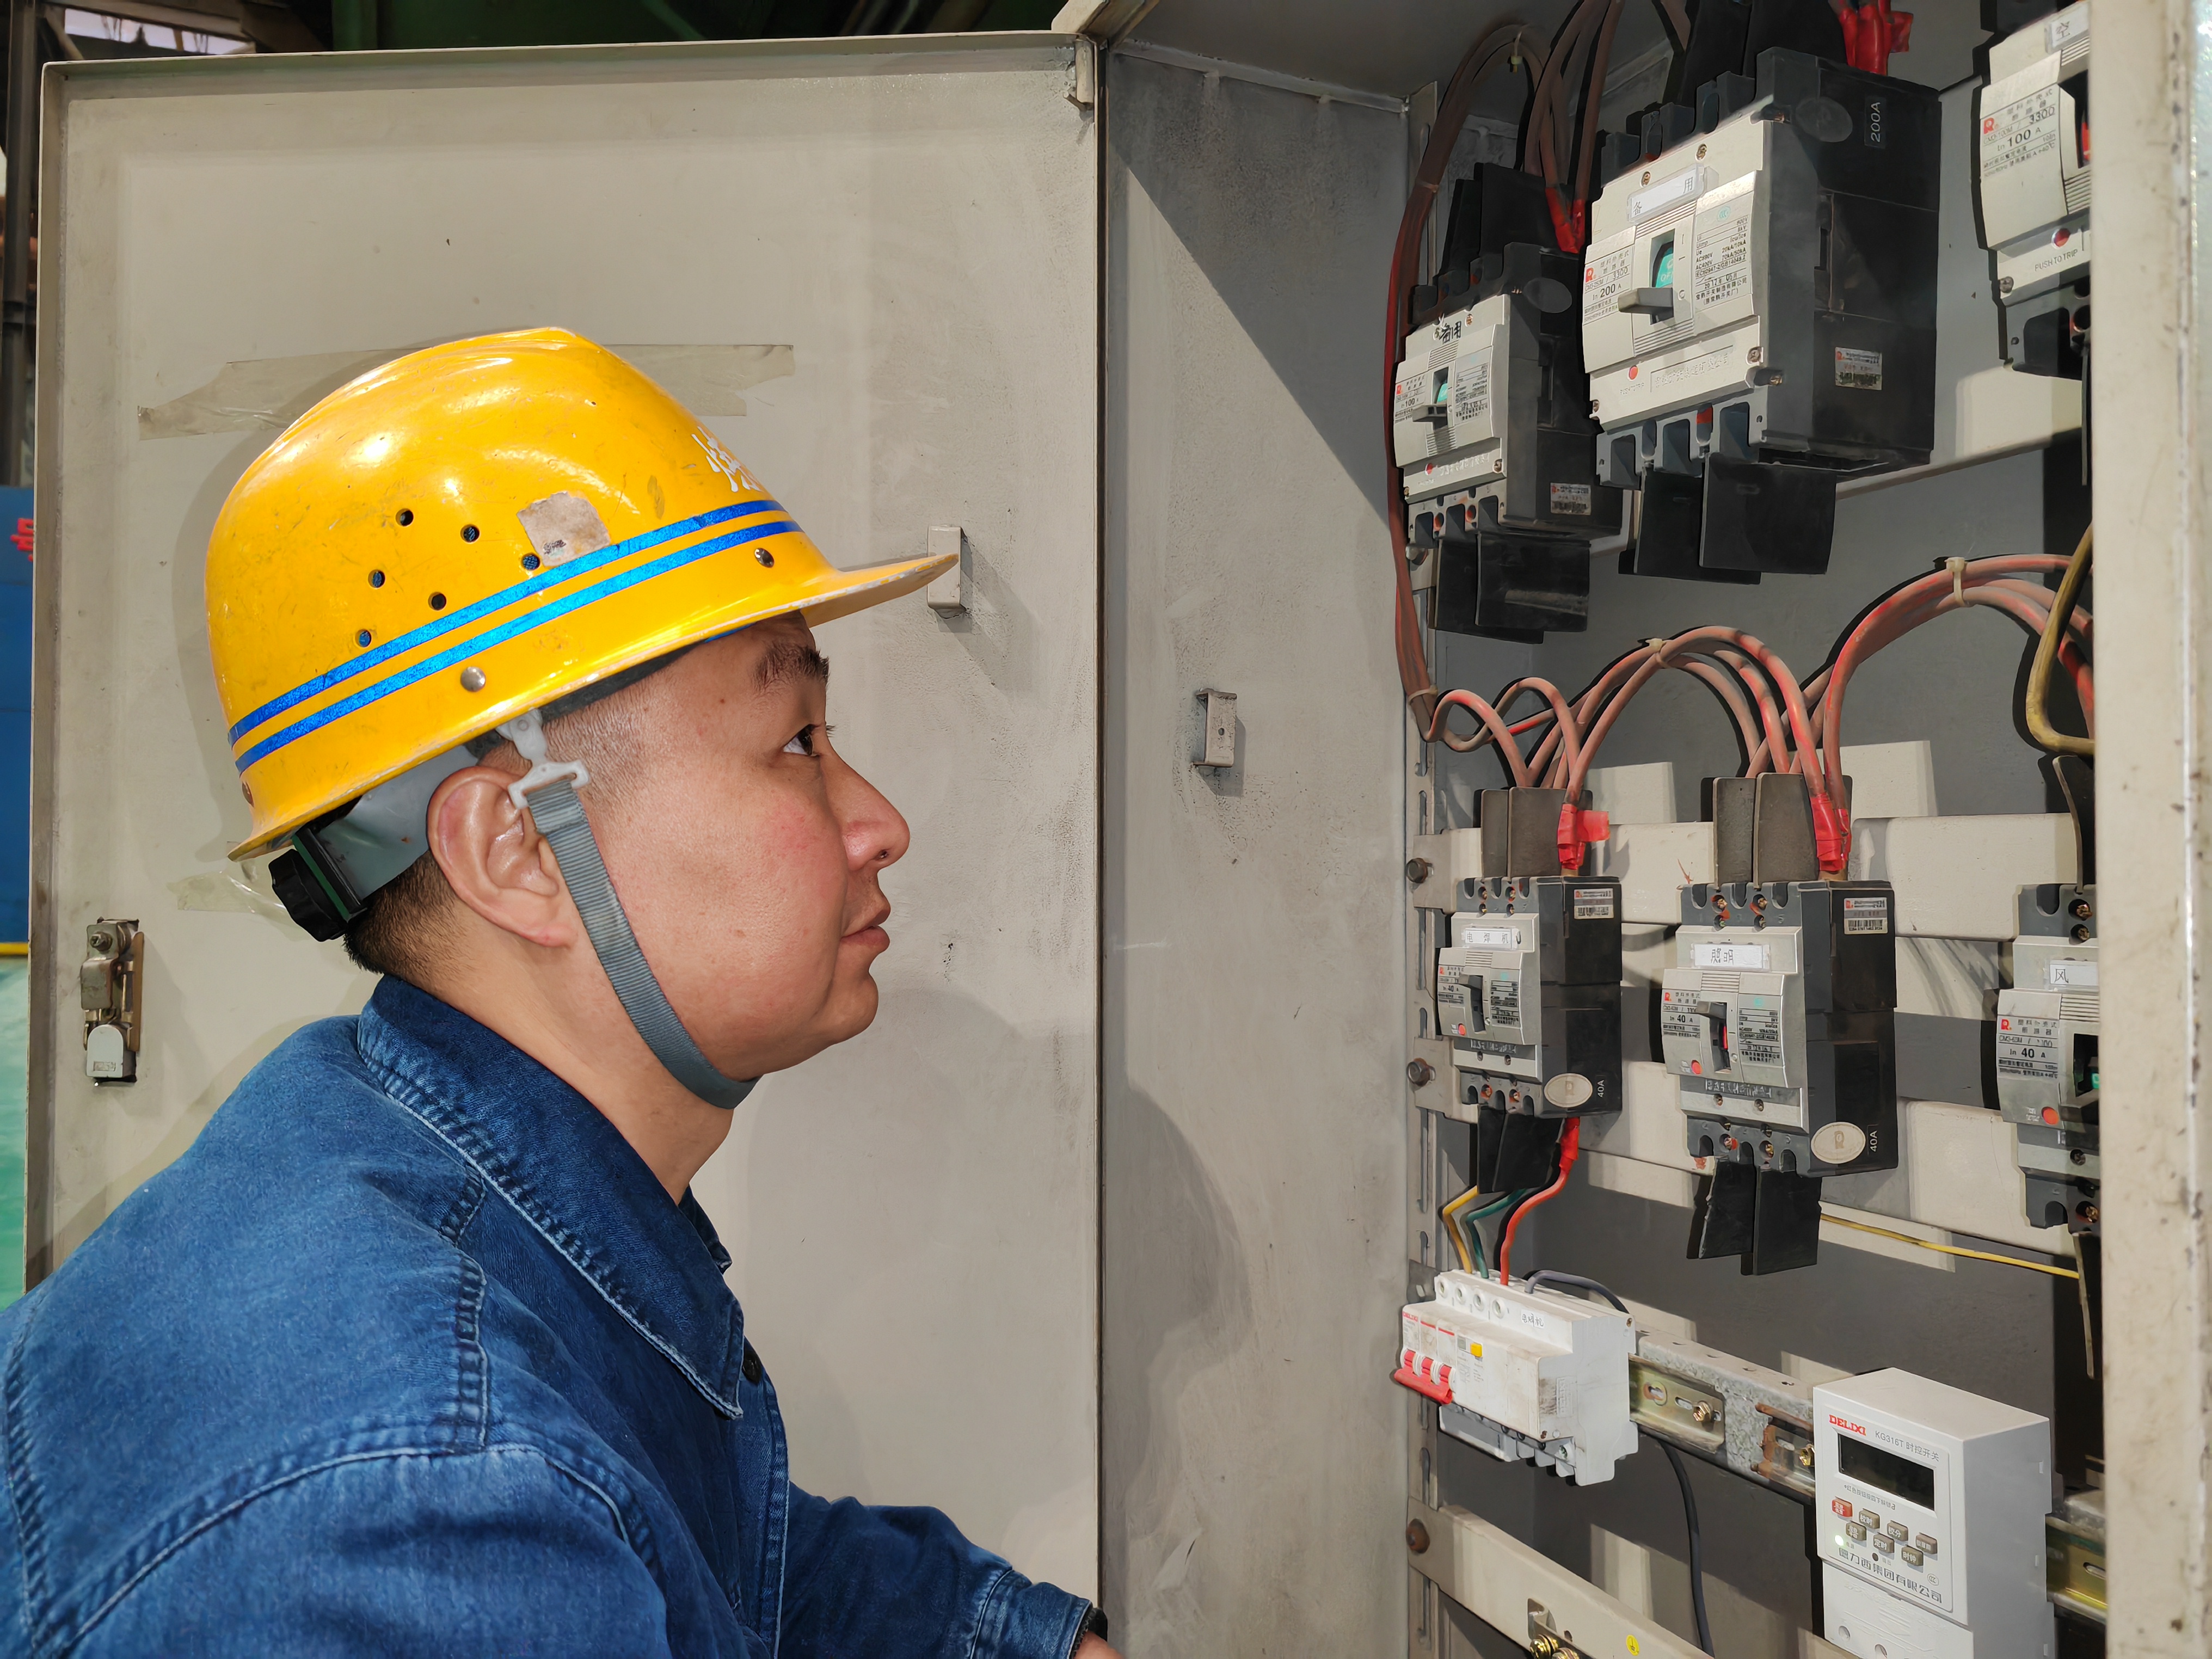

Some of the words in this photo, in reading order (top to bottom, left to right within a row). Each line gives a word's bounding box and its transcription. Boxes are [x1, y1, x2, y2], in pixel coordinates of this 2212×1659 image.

[1871, 102, 1881, 142] 200A
[2007, 129, 2031, 148] 100
[1633, 176, 1694, 216] 备用
[2035, 260, 2053, 272] PUSH
[2054, 255, 2062, 265] TO
[2063, 249, 2078, 261] TRIP
[1600, 284, 1615, 298] 200
[1467, 932, 1509, 944] 电焊机
[2054, 968, 2069, 983] 风
[1677, 1015, 1686, 1023] 40
[2021, 1048, 2035, 1058] 40
[1869, 1130, 1878, 1152] 40A
[1829, 1414, 1866, 1436] DELIXI
[1875, 1430, 1904, 1448] KG316T
[1906, 1441, 1939, 1462] 时控开关
[1860, 1514, 1872, 1526] 校时
[1874, 1539, 1887, 1550] 定时
[1839, 1547, 1942, 1603] 德力西集团有限公司
